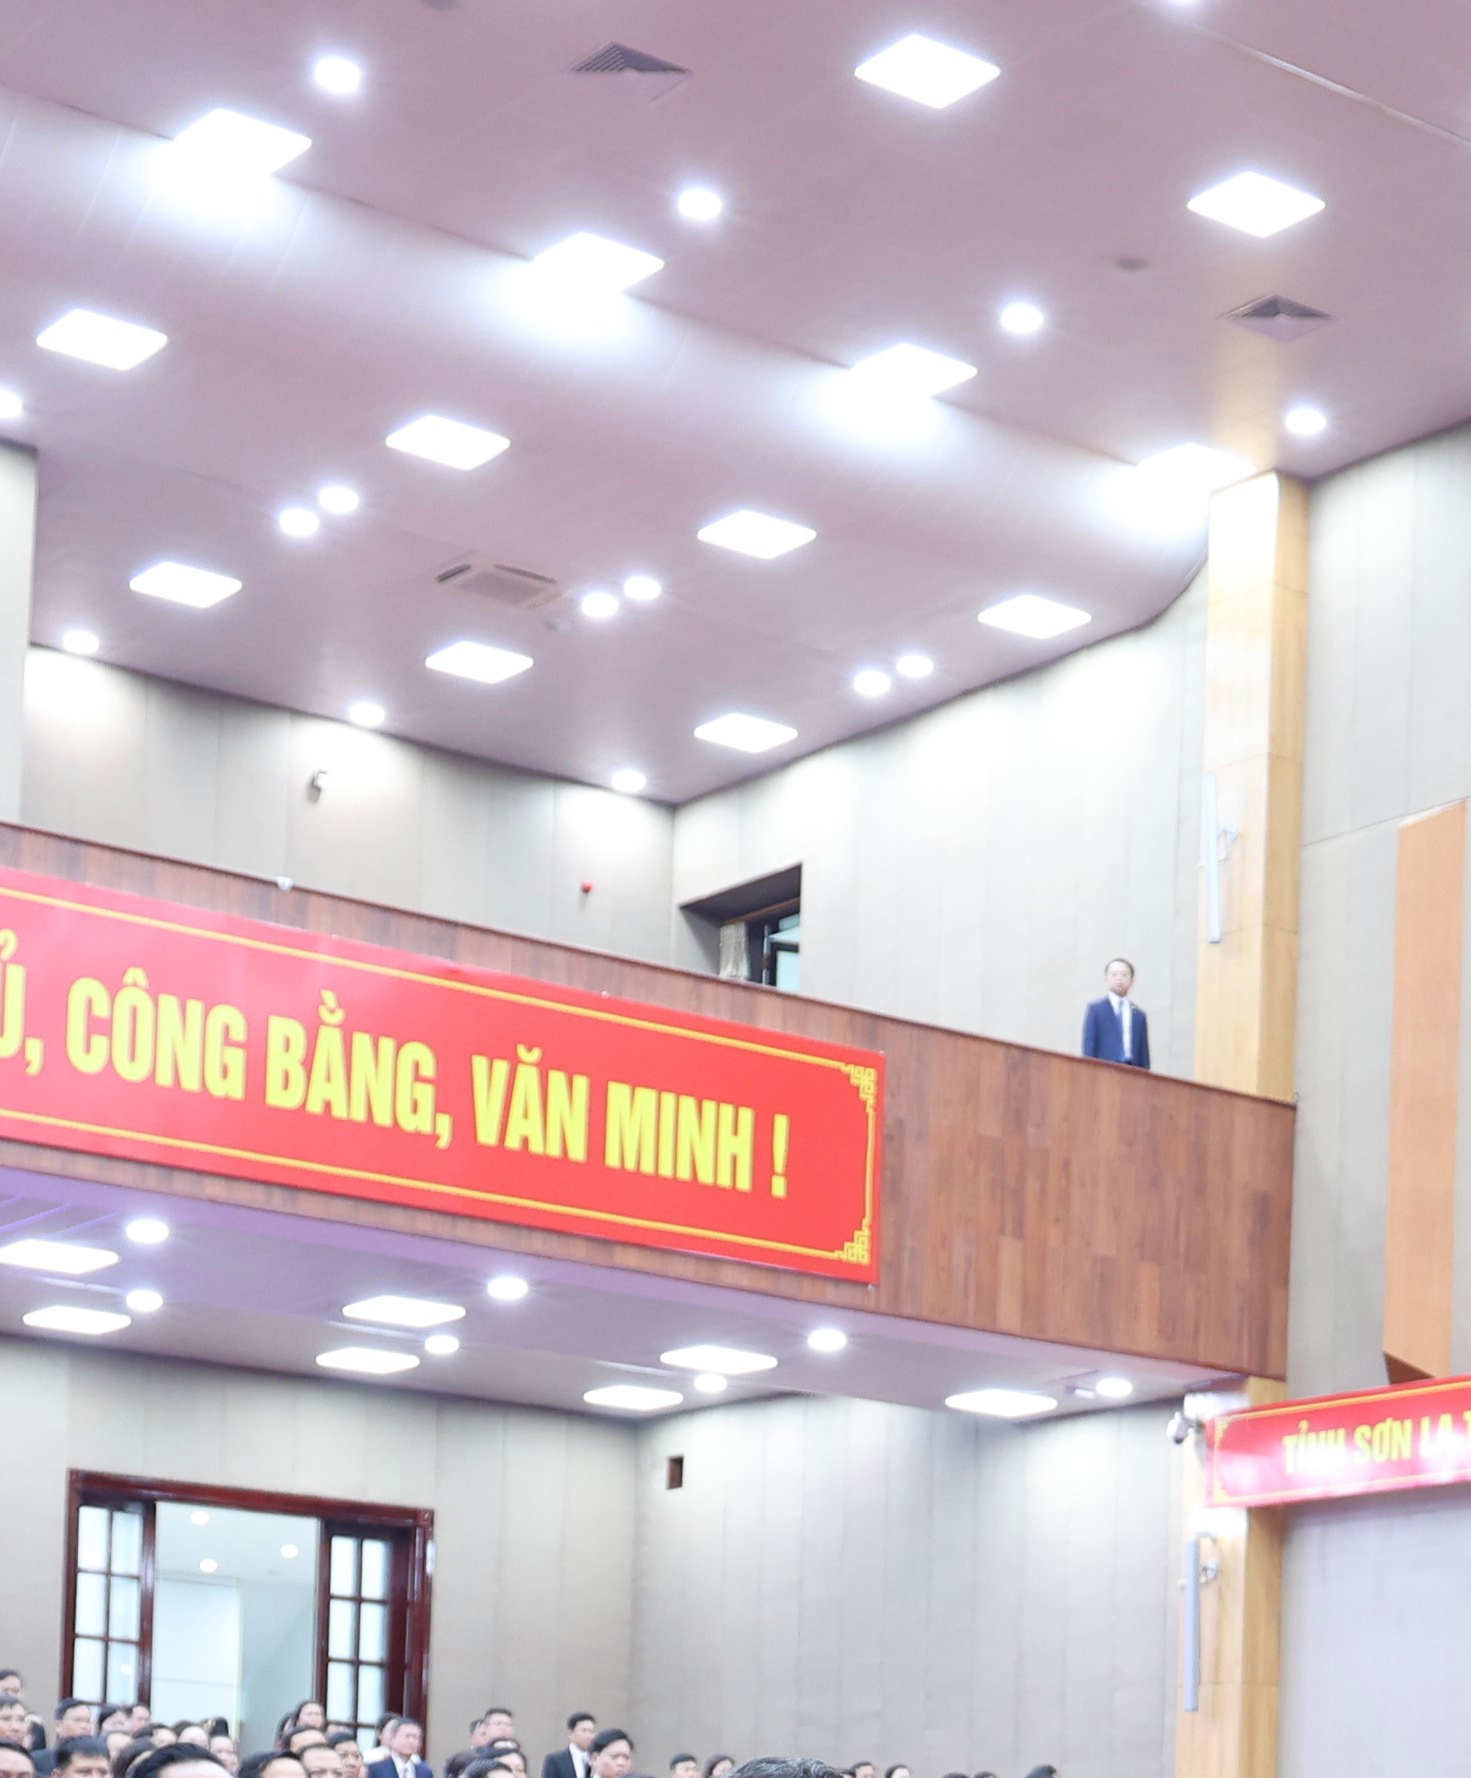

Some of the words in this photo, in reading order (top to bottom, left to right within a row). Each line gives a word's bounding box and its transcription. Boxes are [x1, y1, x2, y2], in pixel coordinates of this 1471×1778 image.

[67, 967, 248, 1100] CÔNG
[265, 989, 454, 1149] BẰNG,
[471, 1045, 588, 1162] VĂN
[605, 1081, 754, 1192] MINH
[771, 1114, 790, 1199] !
[1353, 1417, 1412, 1466] SƠN
